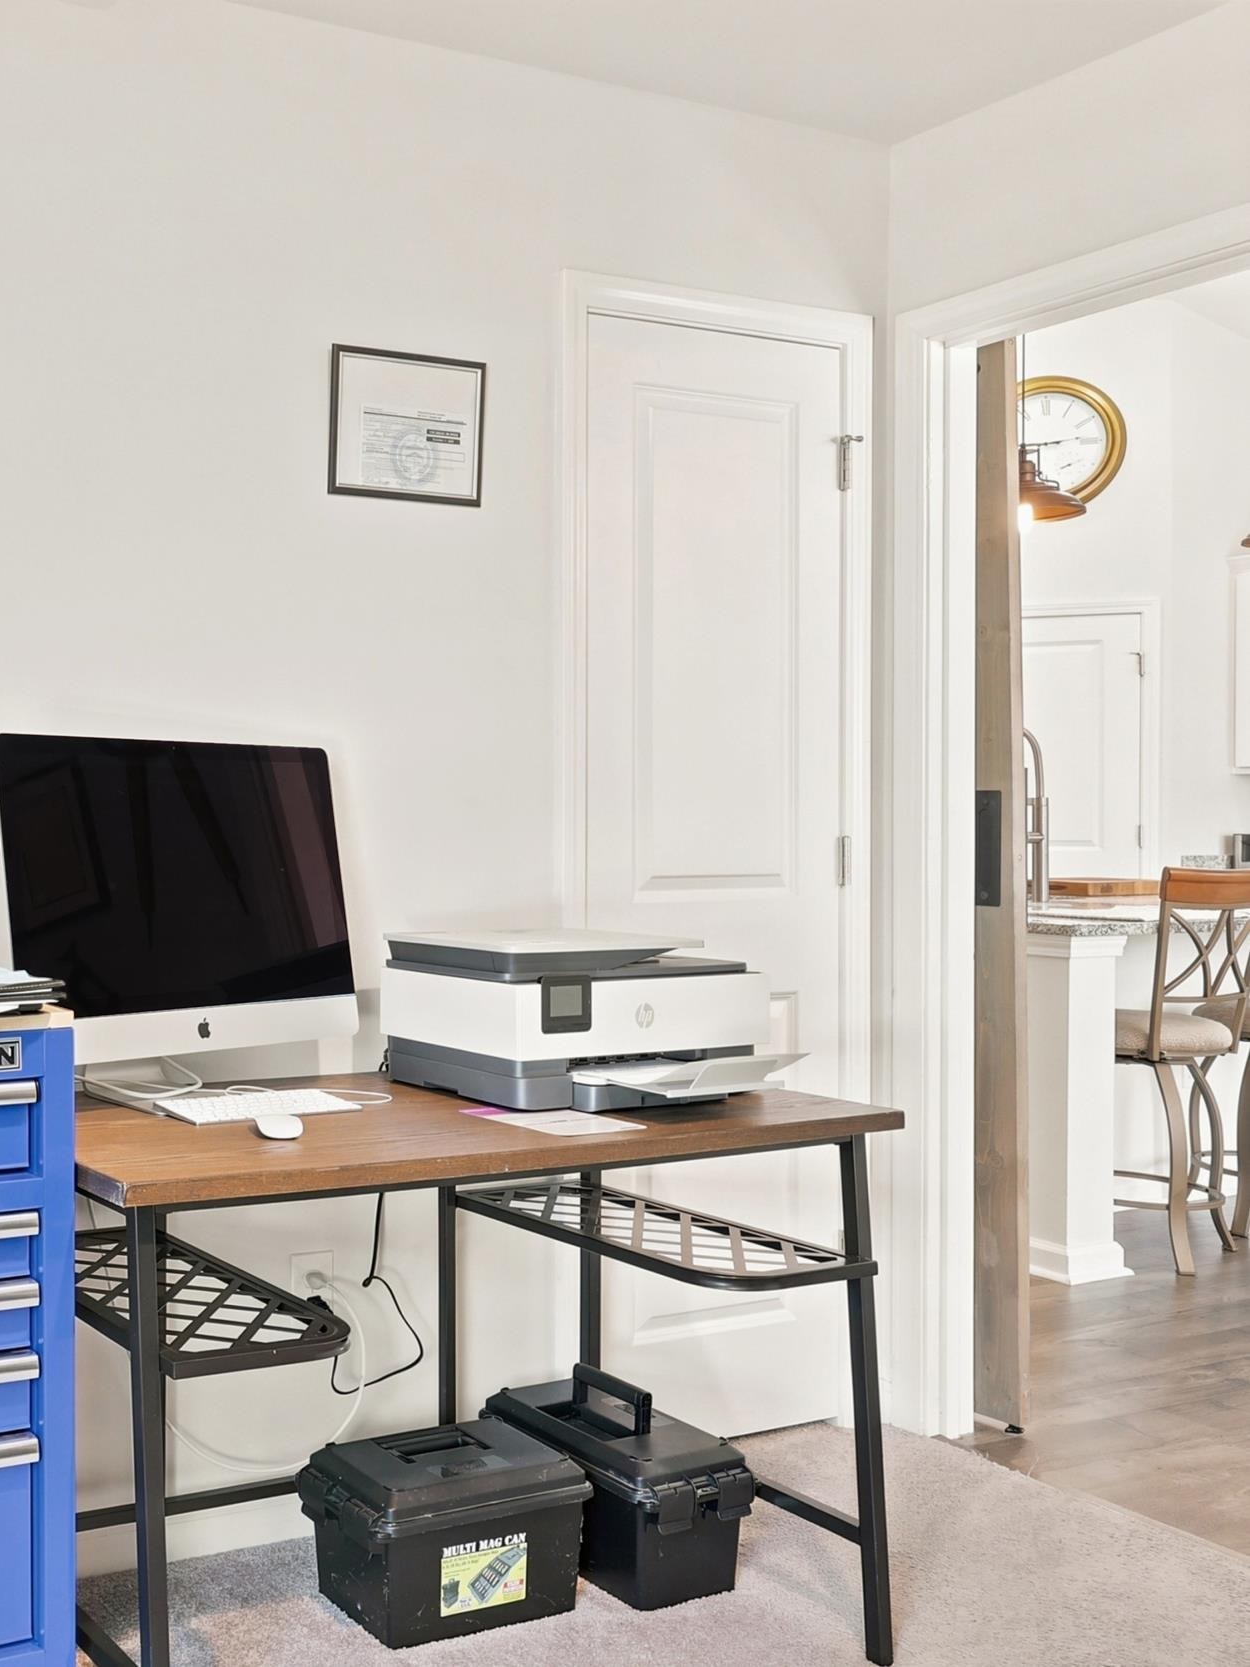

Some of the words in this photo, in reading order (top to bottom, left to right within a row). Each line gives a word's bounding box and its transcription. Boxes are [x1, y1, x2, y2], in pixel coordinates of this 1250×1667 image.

[442, 1542, 477, 1558] MULTI
[478, 1537, 503, 1552] MAG
[504, 1532, 527, 1546] CAN
